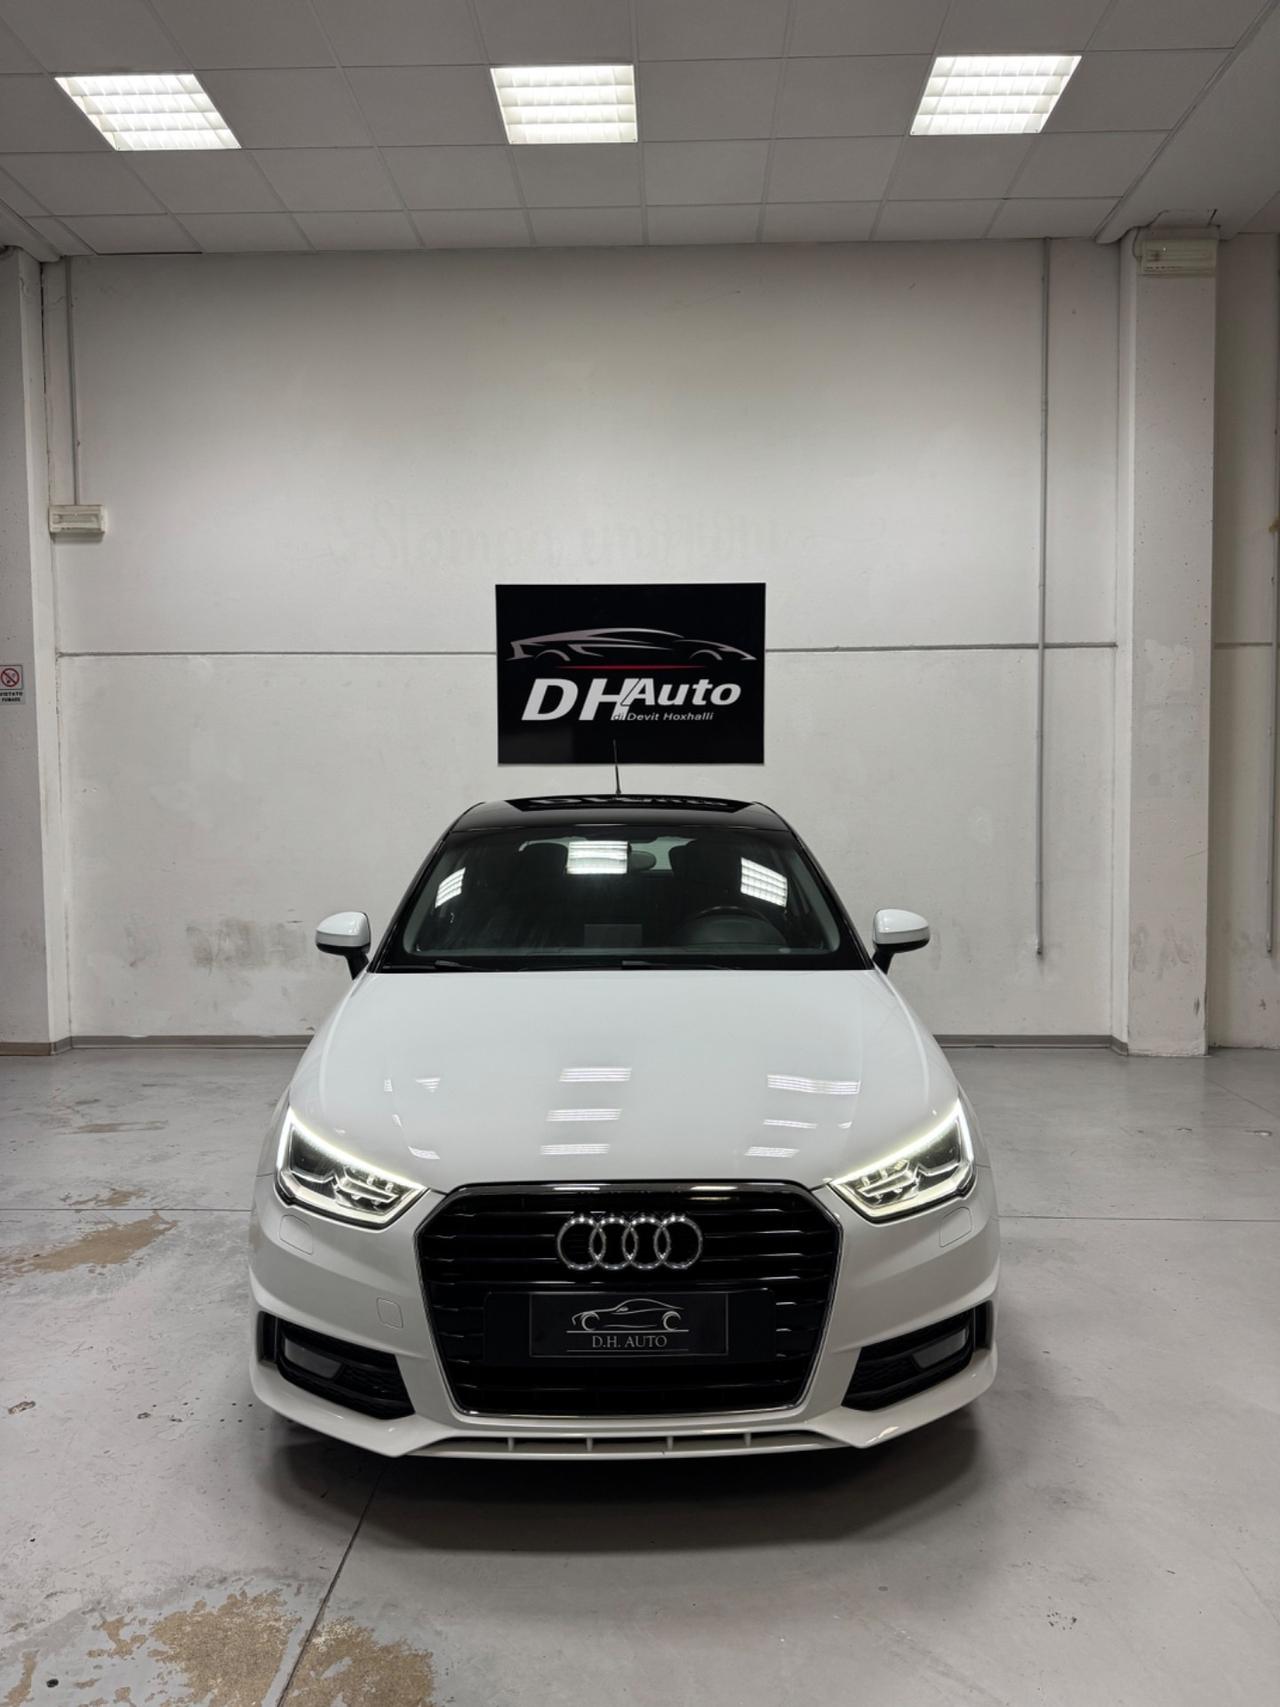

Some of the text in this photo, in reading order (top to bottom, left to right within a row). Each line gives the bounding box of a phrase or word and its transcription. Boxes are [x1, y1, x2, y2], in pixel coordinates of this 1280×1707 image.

[627, 712, 660, 721] Devit
[663, 712, 714, 721] Hoxhalli
[592, 1335, 668, 1348] D.H. AUTO
